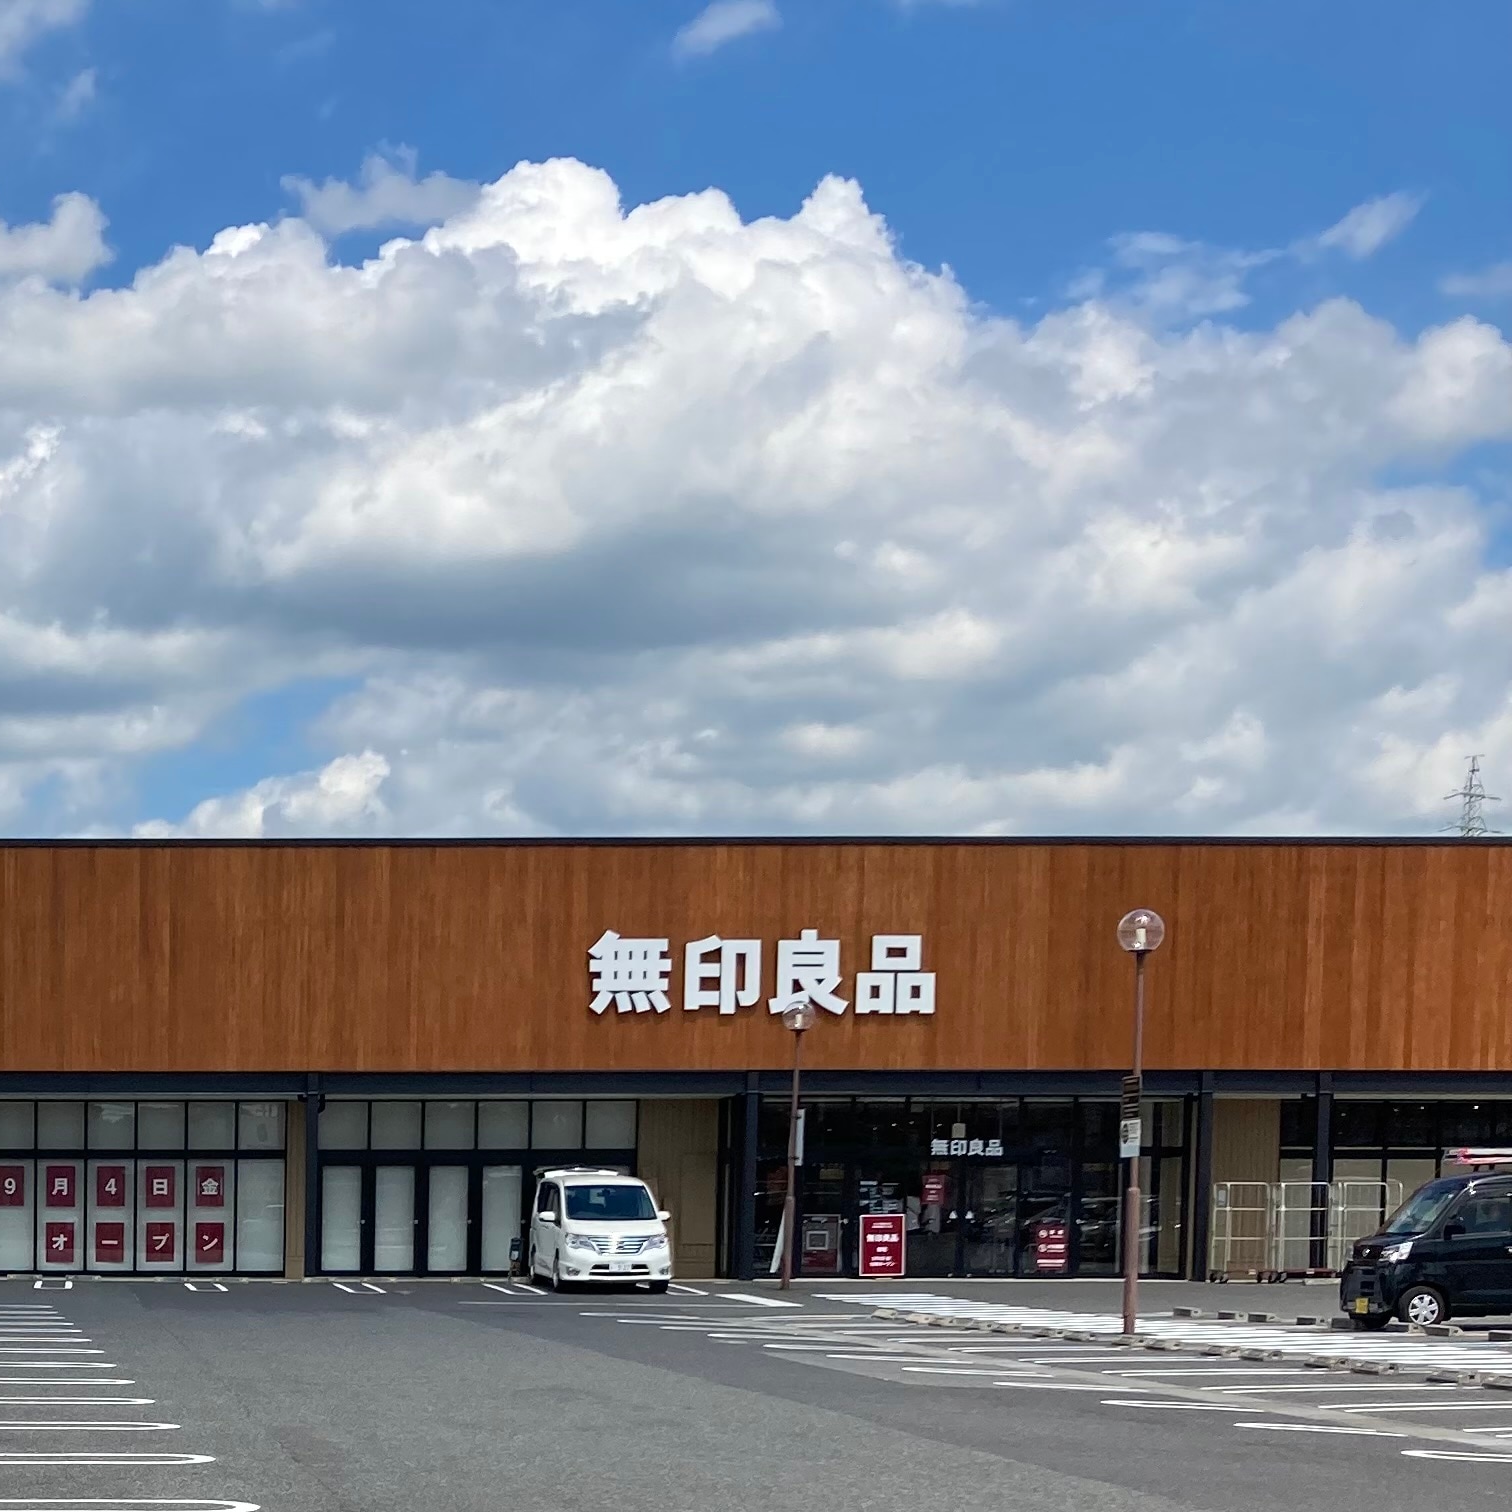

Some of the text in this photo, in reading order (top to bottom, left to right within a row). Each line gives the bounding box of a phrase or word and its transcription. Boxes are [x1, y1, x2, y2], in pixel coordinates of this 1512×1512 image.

[587, 929, 936, 1015] 無印良品
[930, 1138, 1004, 1156] 無印良品
[51, 1233, 219, 1251] オープン
